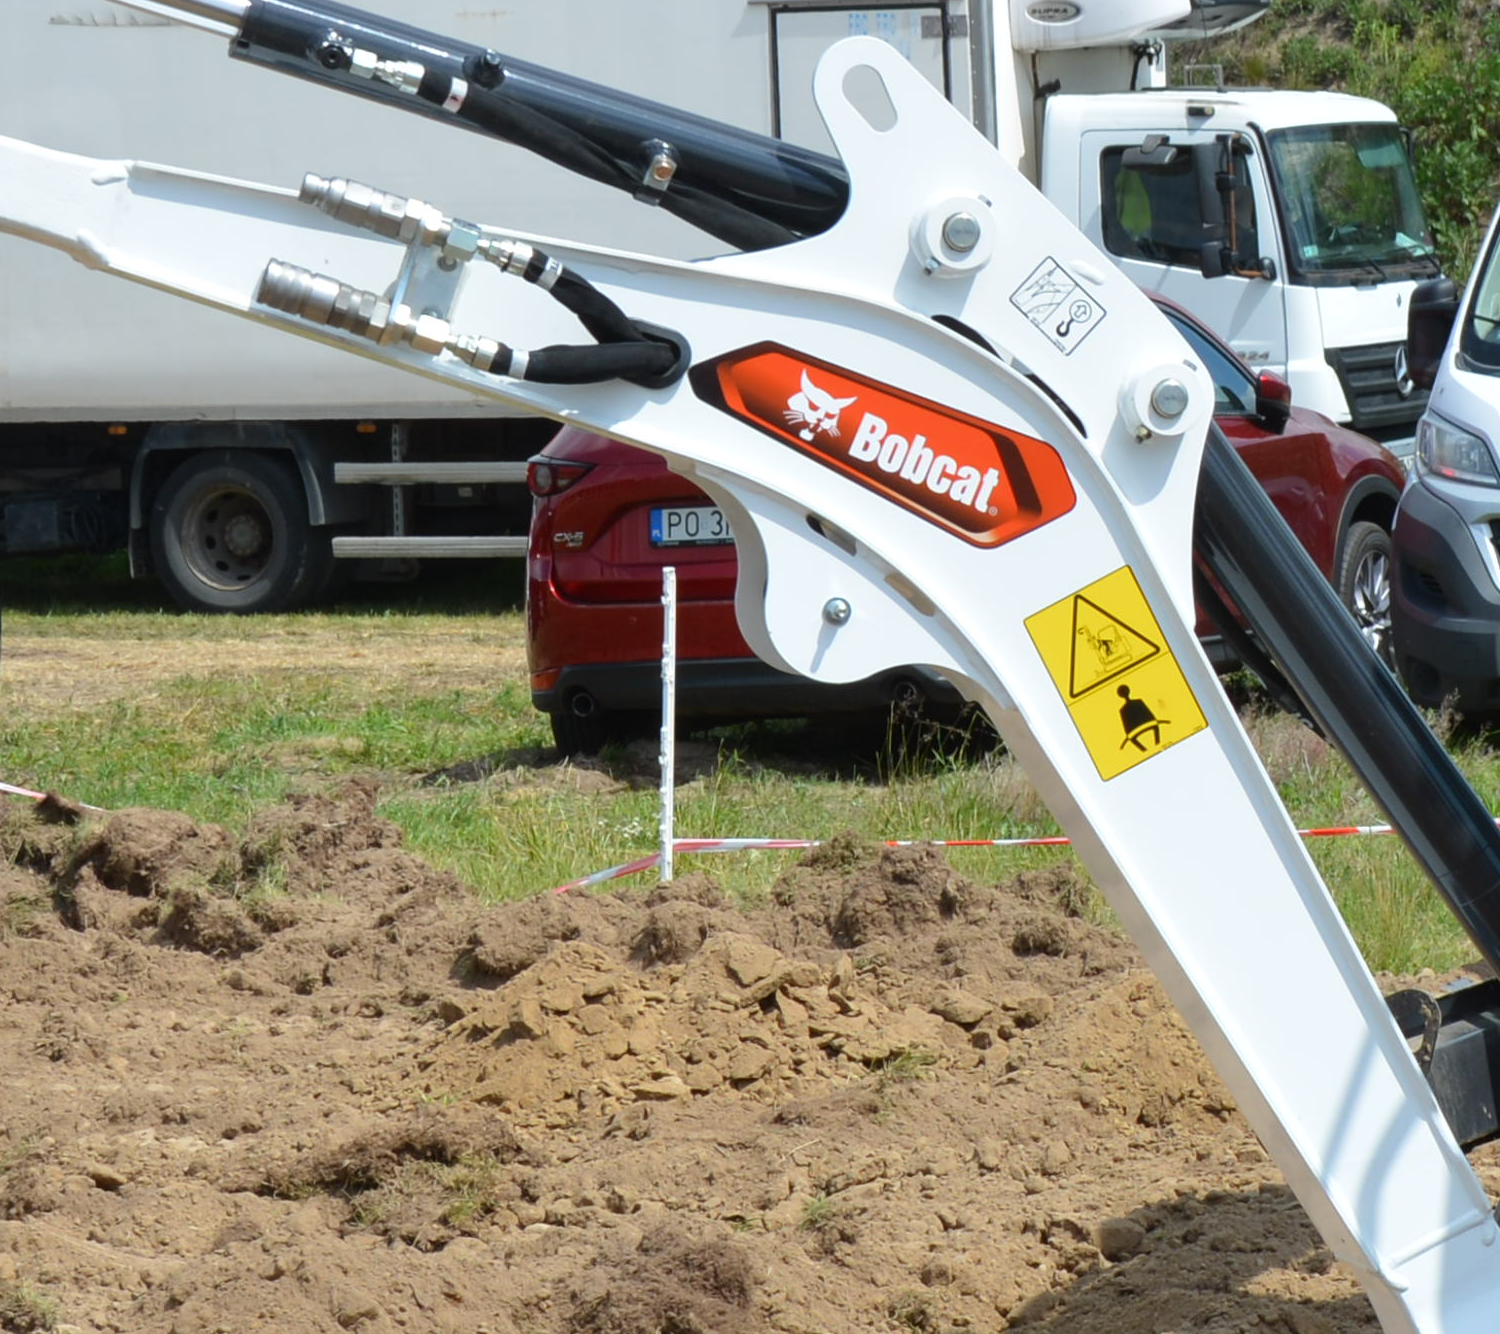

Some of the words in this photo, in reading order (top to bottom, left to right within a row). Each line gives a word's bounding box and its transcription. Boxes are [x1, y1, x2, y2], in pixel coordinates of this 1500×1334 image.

[848, 411, 1000, 514] Bobcat
[667, 511, 699, 538] PO
[711, 510, 730, 536] 3
